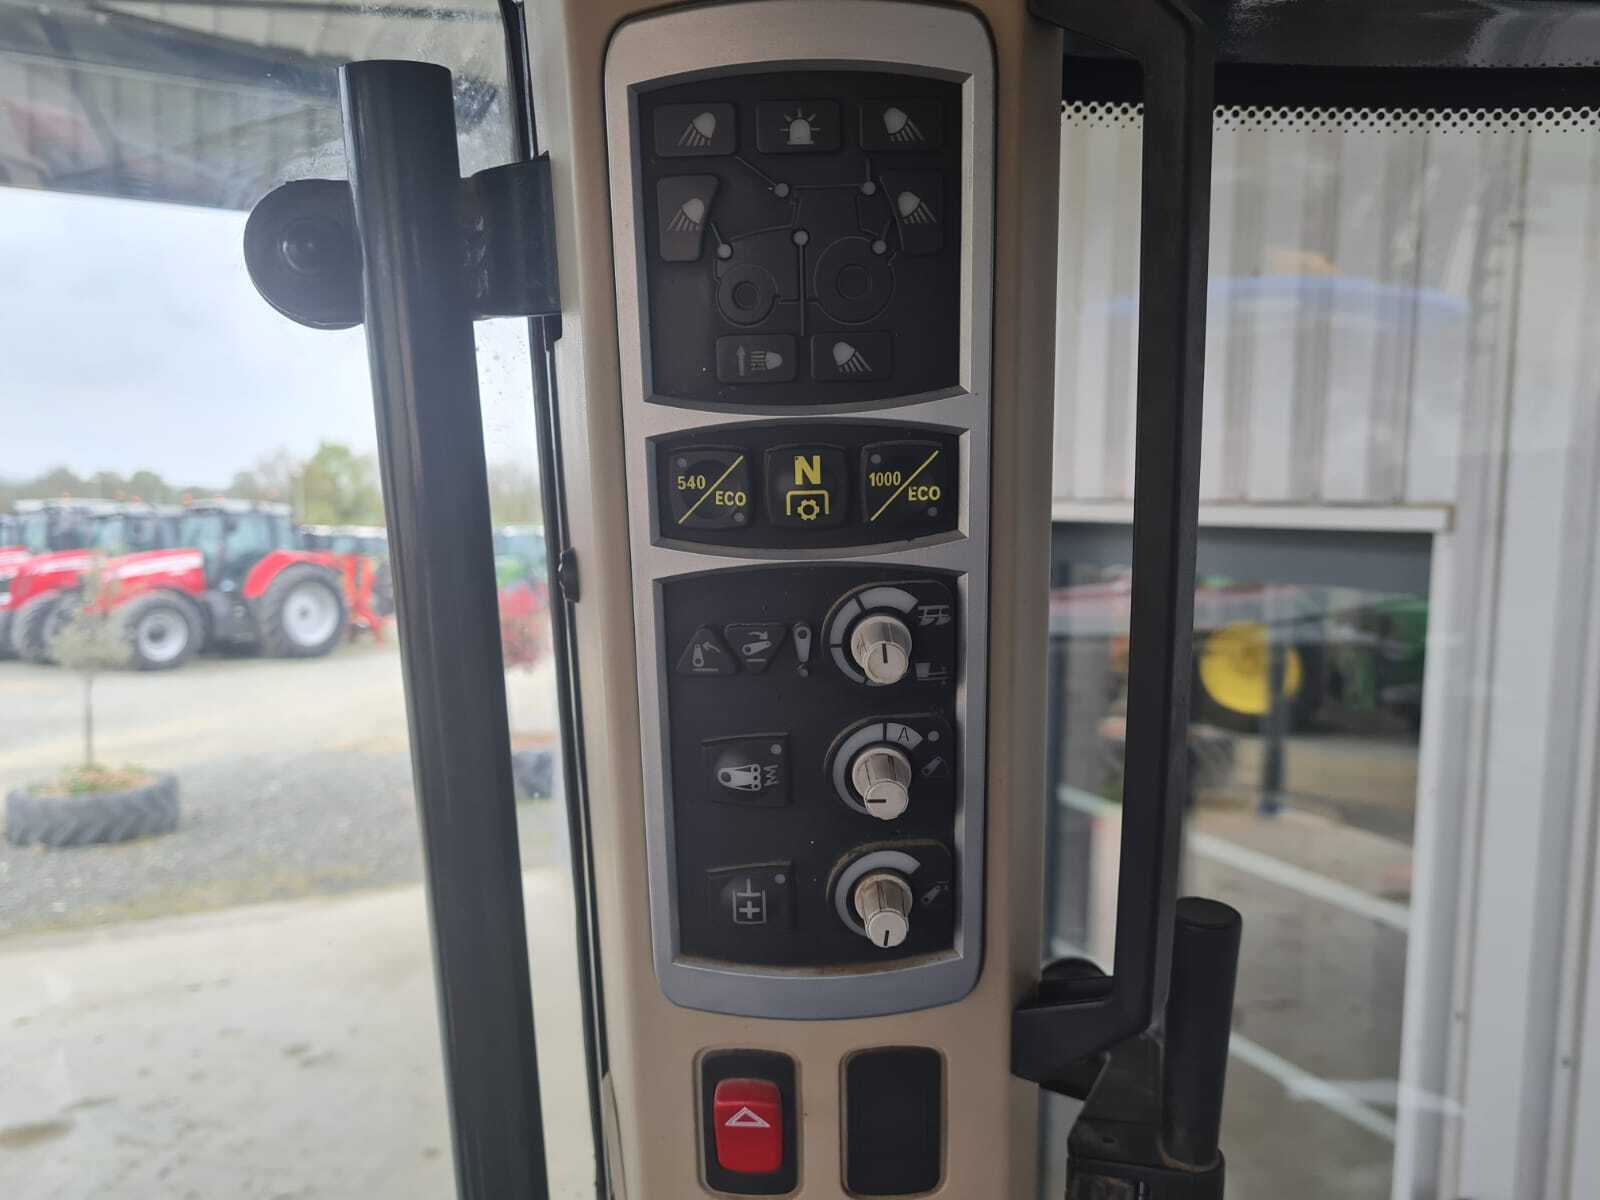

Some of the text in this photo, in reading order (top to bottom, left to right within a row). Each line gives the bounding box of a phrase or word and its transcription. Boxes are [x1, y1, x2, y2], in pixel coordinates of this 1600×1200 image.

[794, 455, 821, 485] N
[677, 474, 706, 490] 540
[868, 471, 901, 487] 1000
[715, 491, 747, 506] ECO
[907, 486, 941, 501] ECO
[897, 727, 910, 742] A
